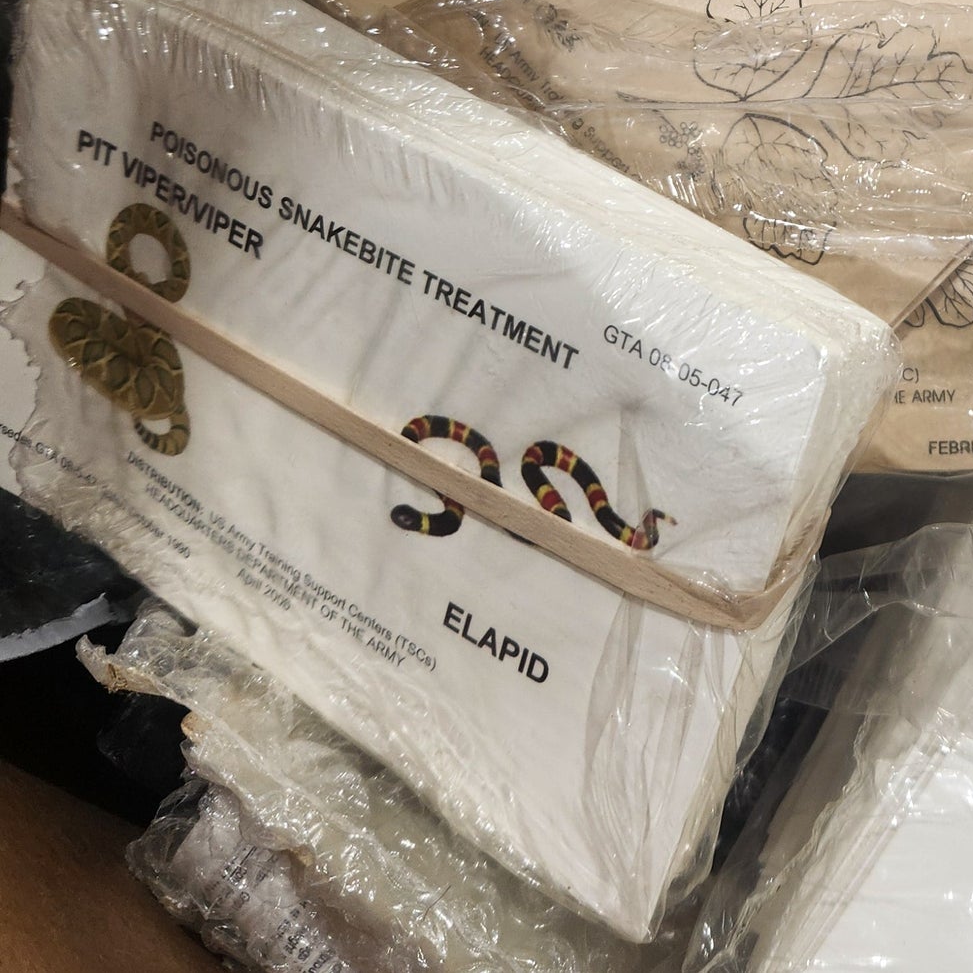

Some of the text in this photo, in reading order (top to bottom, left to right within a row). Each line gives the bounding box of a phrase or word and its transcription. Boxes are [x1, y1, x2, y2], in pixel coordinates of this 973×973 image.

[77, 129, 264, 259] PIT VIPER/VIPER
[149, 121, 580, 370] POISONOUS SNAKEBITE TREATMENT
[603, 324, 643, 359] GTA
[911, 389, 956, 404] ARMY
[442, 601, 549, 684] ELAPID
